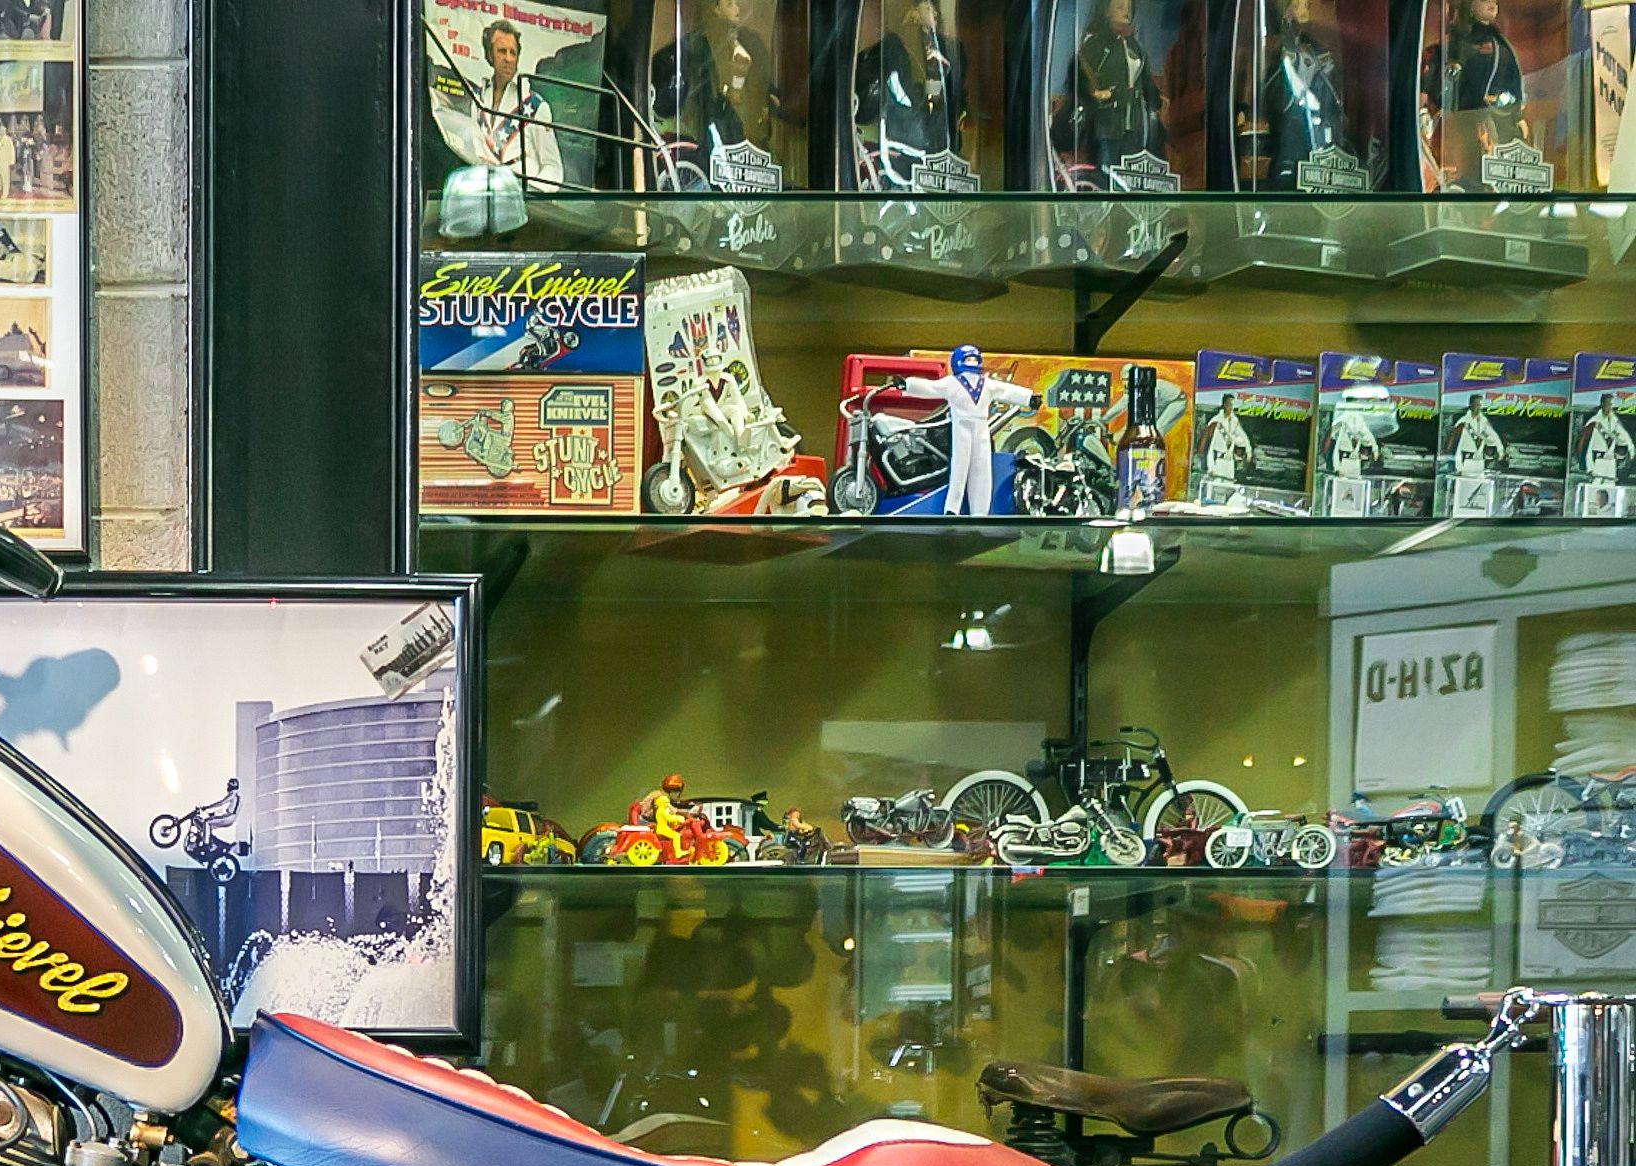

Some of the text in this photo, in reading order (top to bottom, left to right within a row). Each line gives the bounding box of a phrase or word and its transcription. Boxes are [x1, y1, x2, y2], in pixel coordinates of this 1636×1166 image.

[727, 212, 777, 252] Barbie
[927, 220, 976, 260] Barbie
[421, 262, 637, 301] Evel Knievel
[419, 293, 640, 328] STUNT CYCLE
[545, 407, 609, 421] KNIEVEL
[532, 435, 600, 473] STUNT
[563, 457, 623, 494] CYCLE
